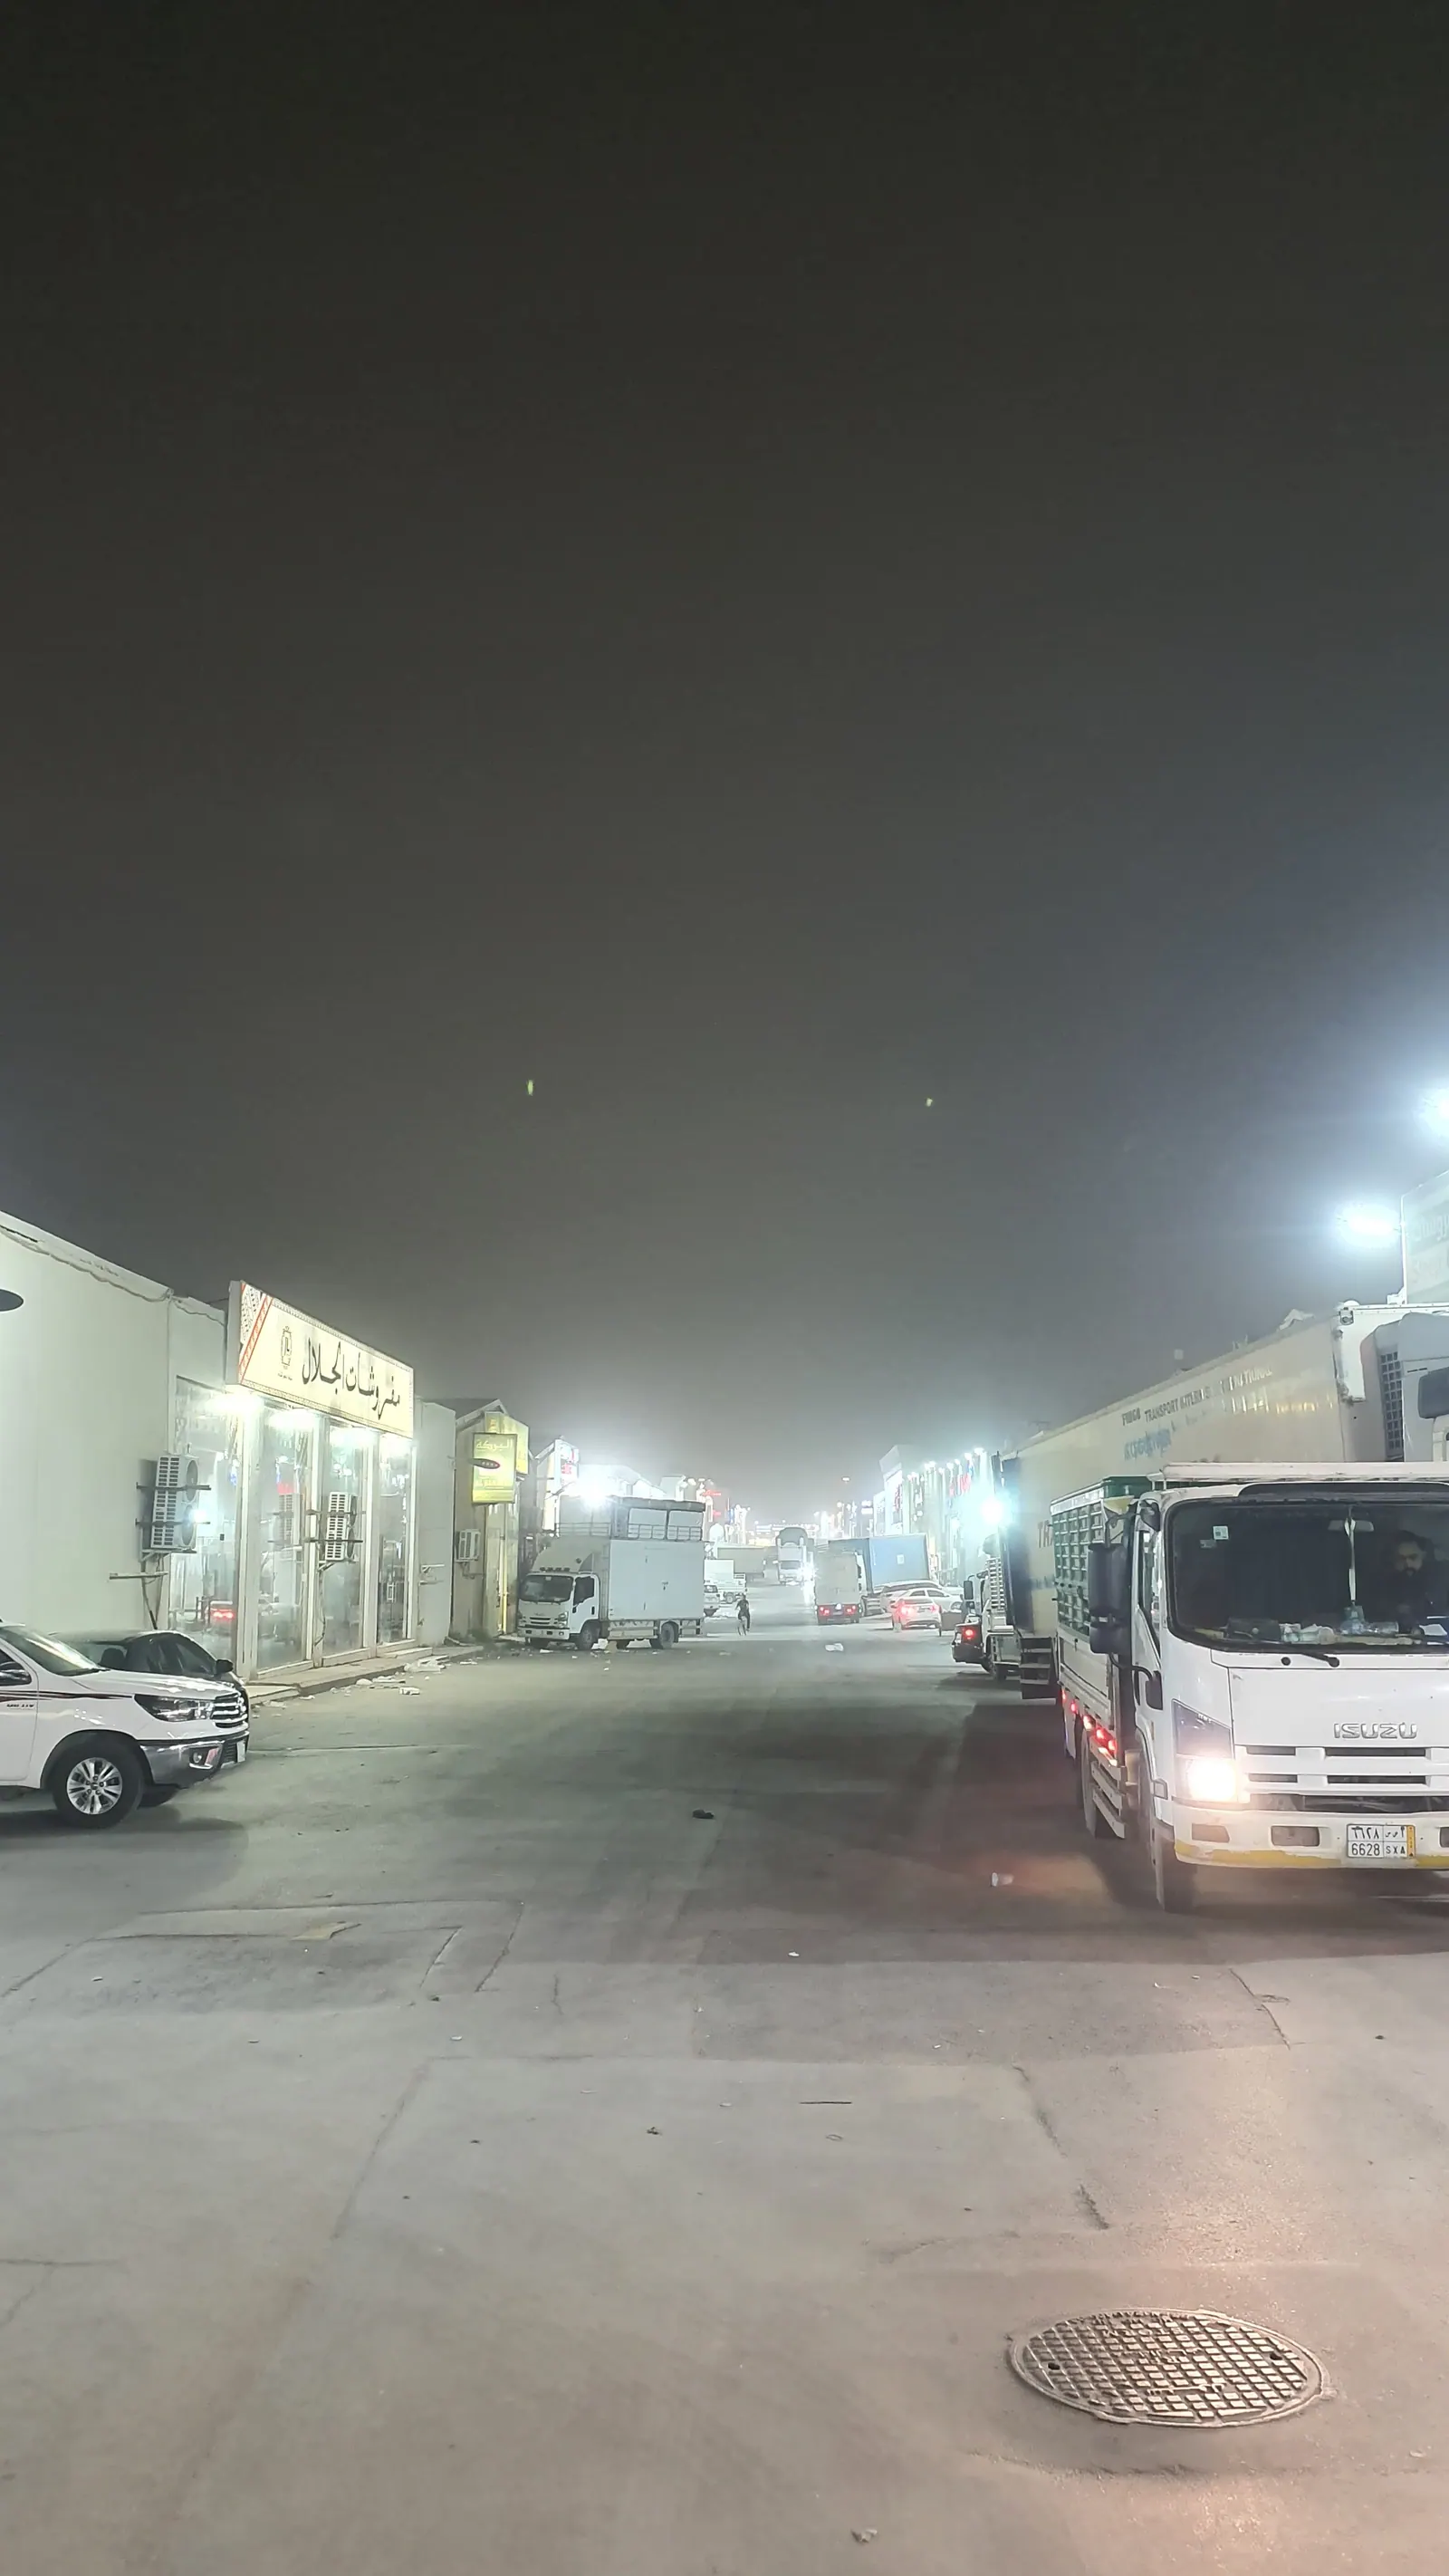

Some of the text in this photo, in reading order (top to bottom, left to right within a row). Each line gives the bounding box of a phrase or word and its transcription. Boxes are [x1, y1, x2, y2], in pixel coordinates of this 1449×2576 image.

[302, 1337, 400, 1420] مفروشات الجلال
[1333, 1723, 1417, 1740] ISUZU
[1351, 1842, 1380, 1857] 6628
